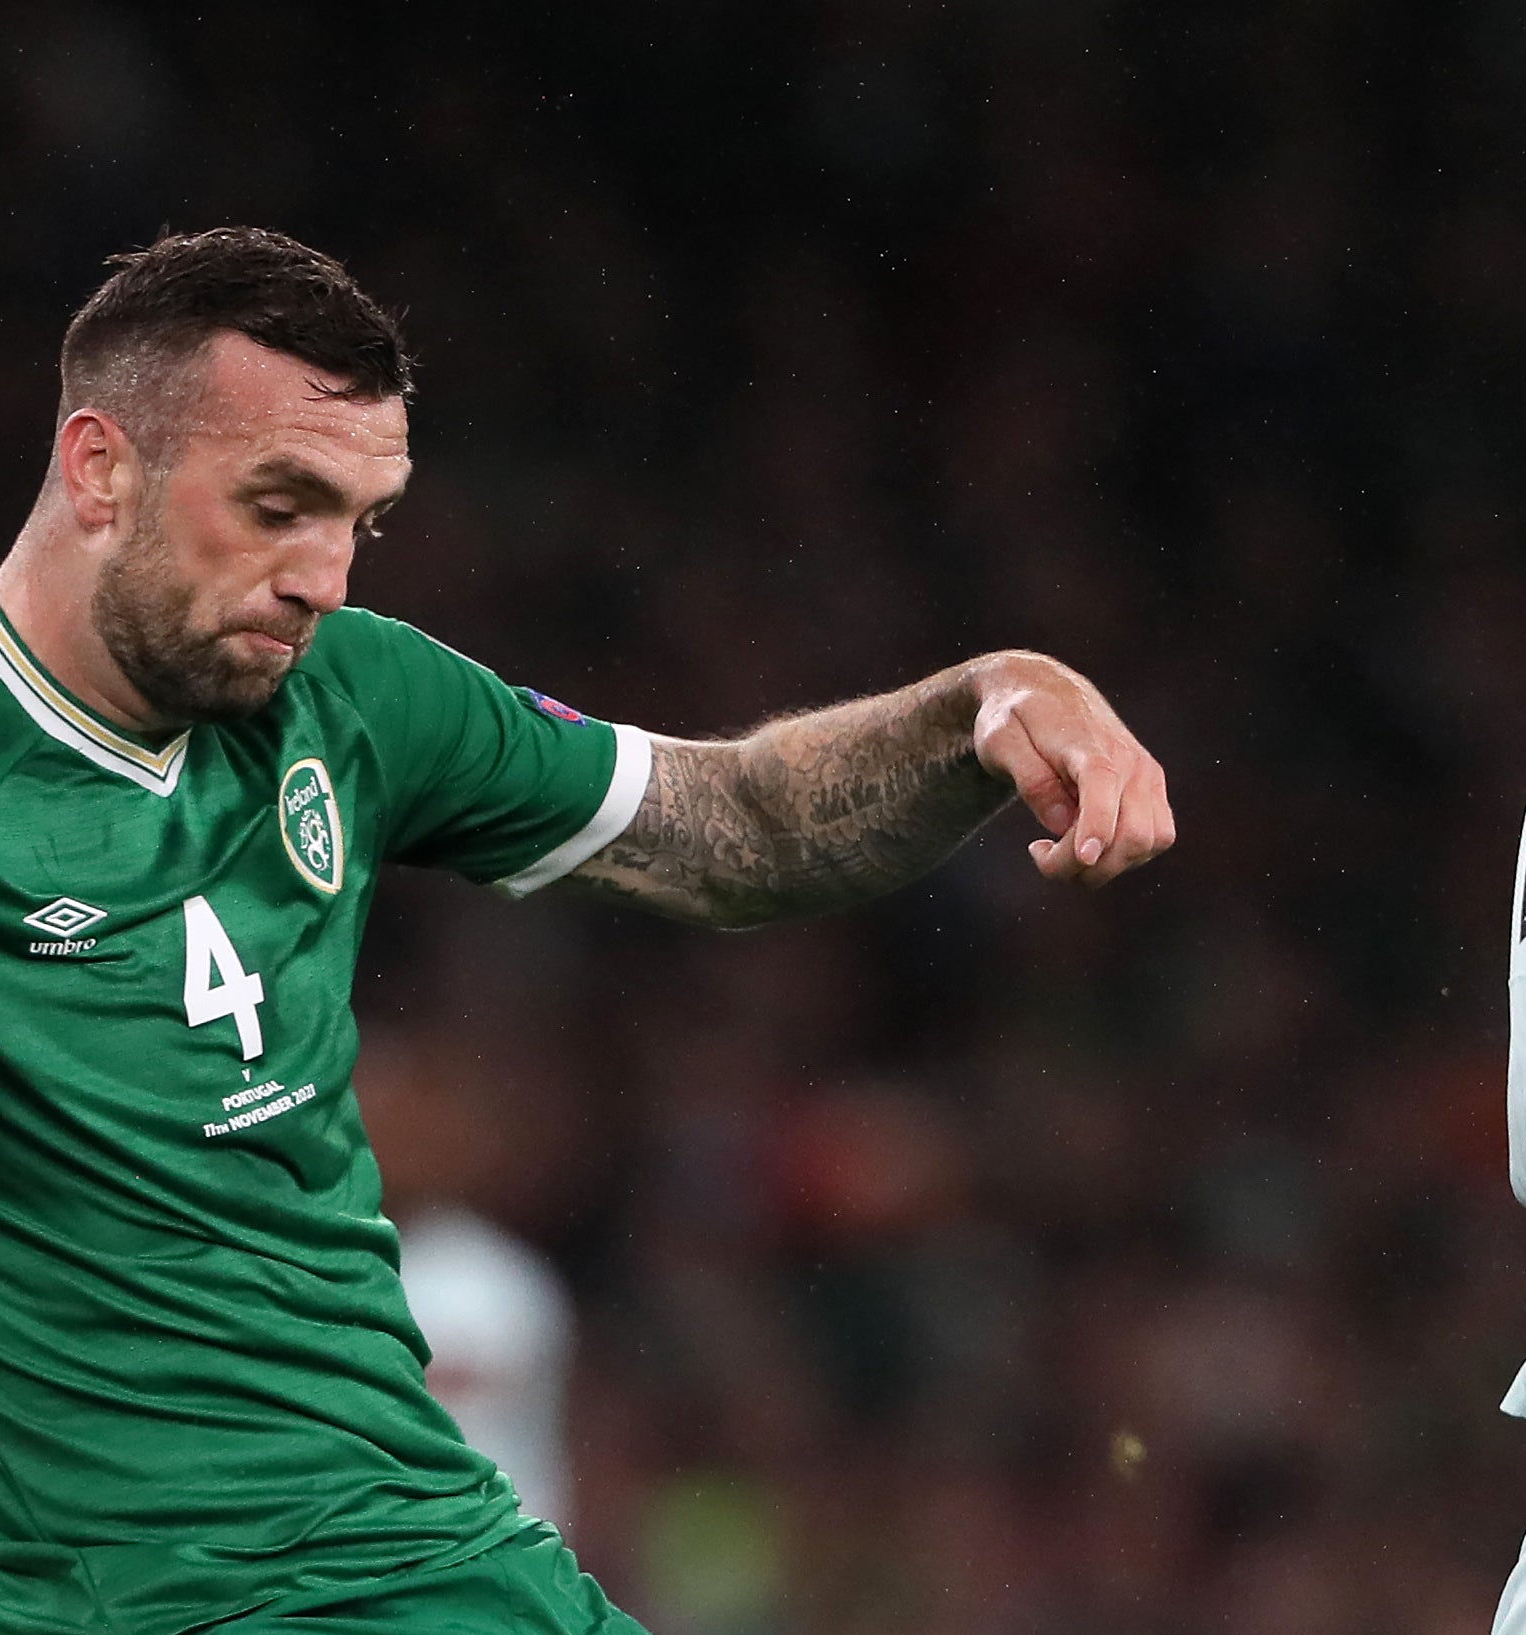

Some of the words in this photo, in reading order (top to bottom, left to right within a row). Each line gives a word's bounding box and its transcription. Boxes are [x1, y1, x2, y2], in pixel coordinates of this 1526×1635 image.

[29, 938, 97, 955] umbro
[183, 895, 265, 1061] 4
[221, 1080, 285, 1112] PORTUGAL
[228, 1096, 296, 1131] NOVEMBER
[291, 1083, 316, 1105] 2021
